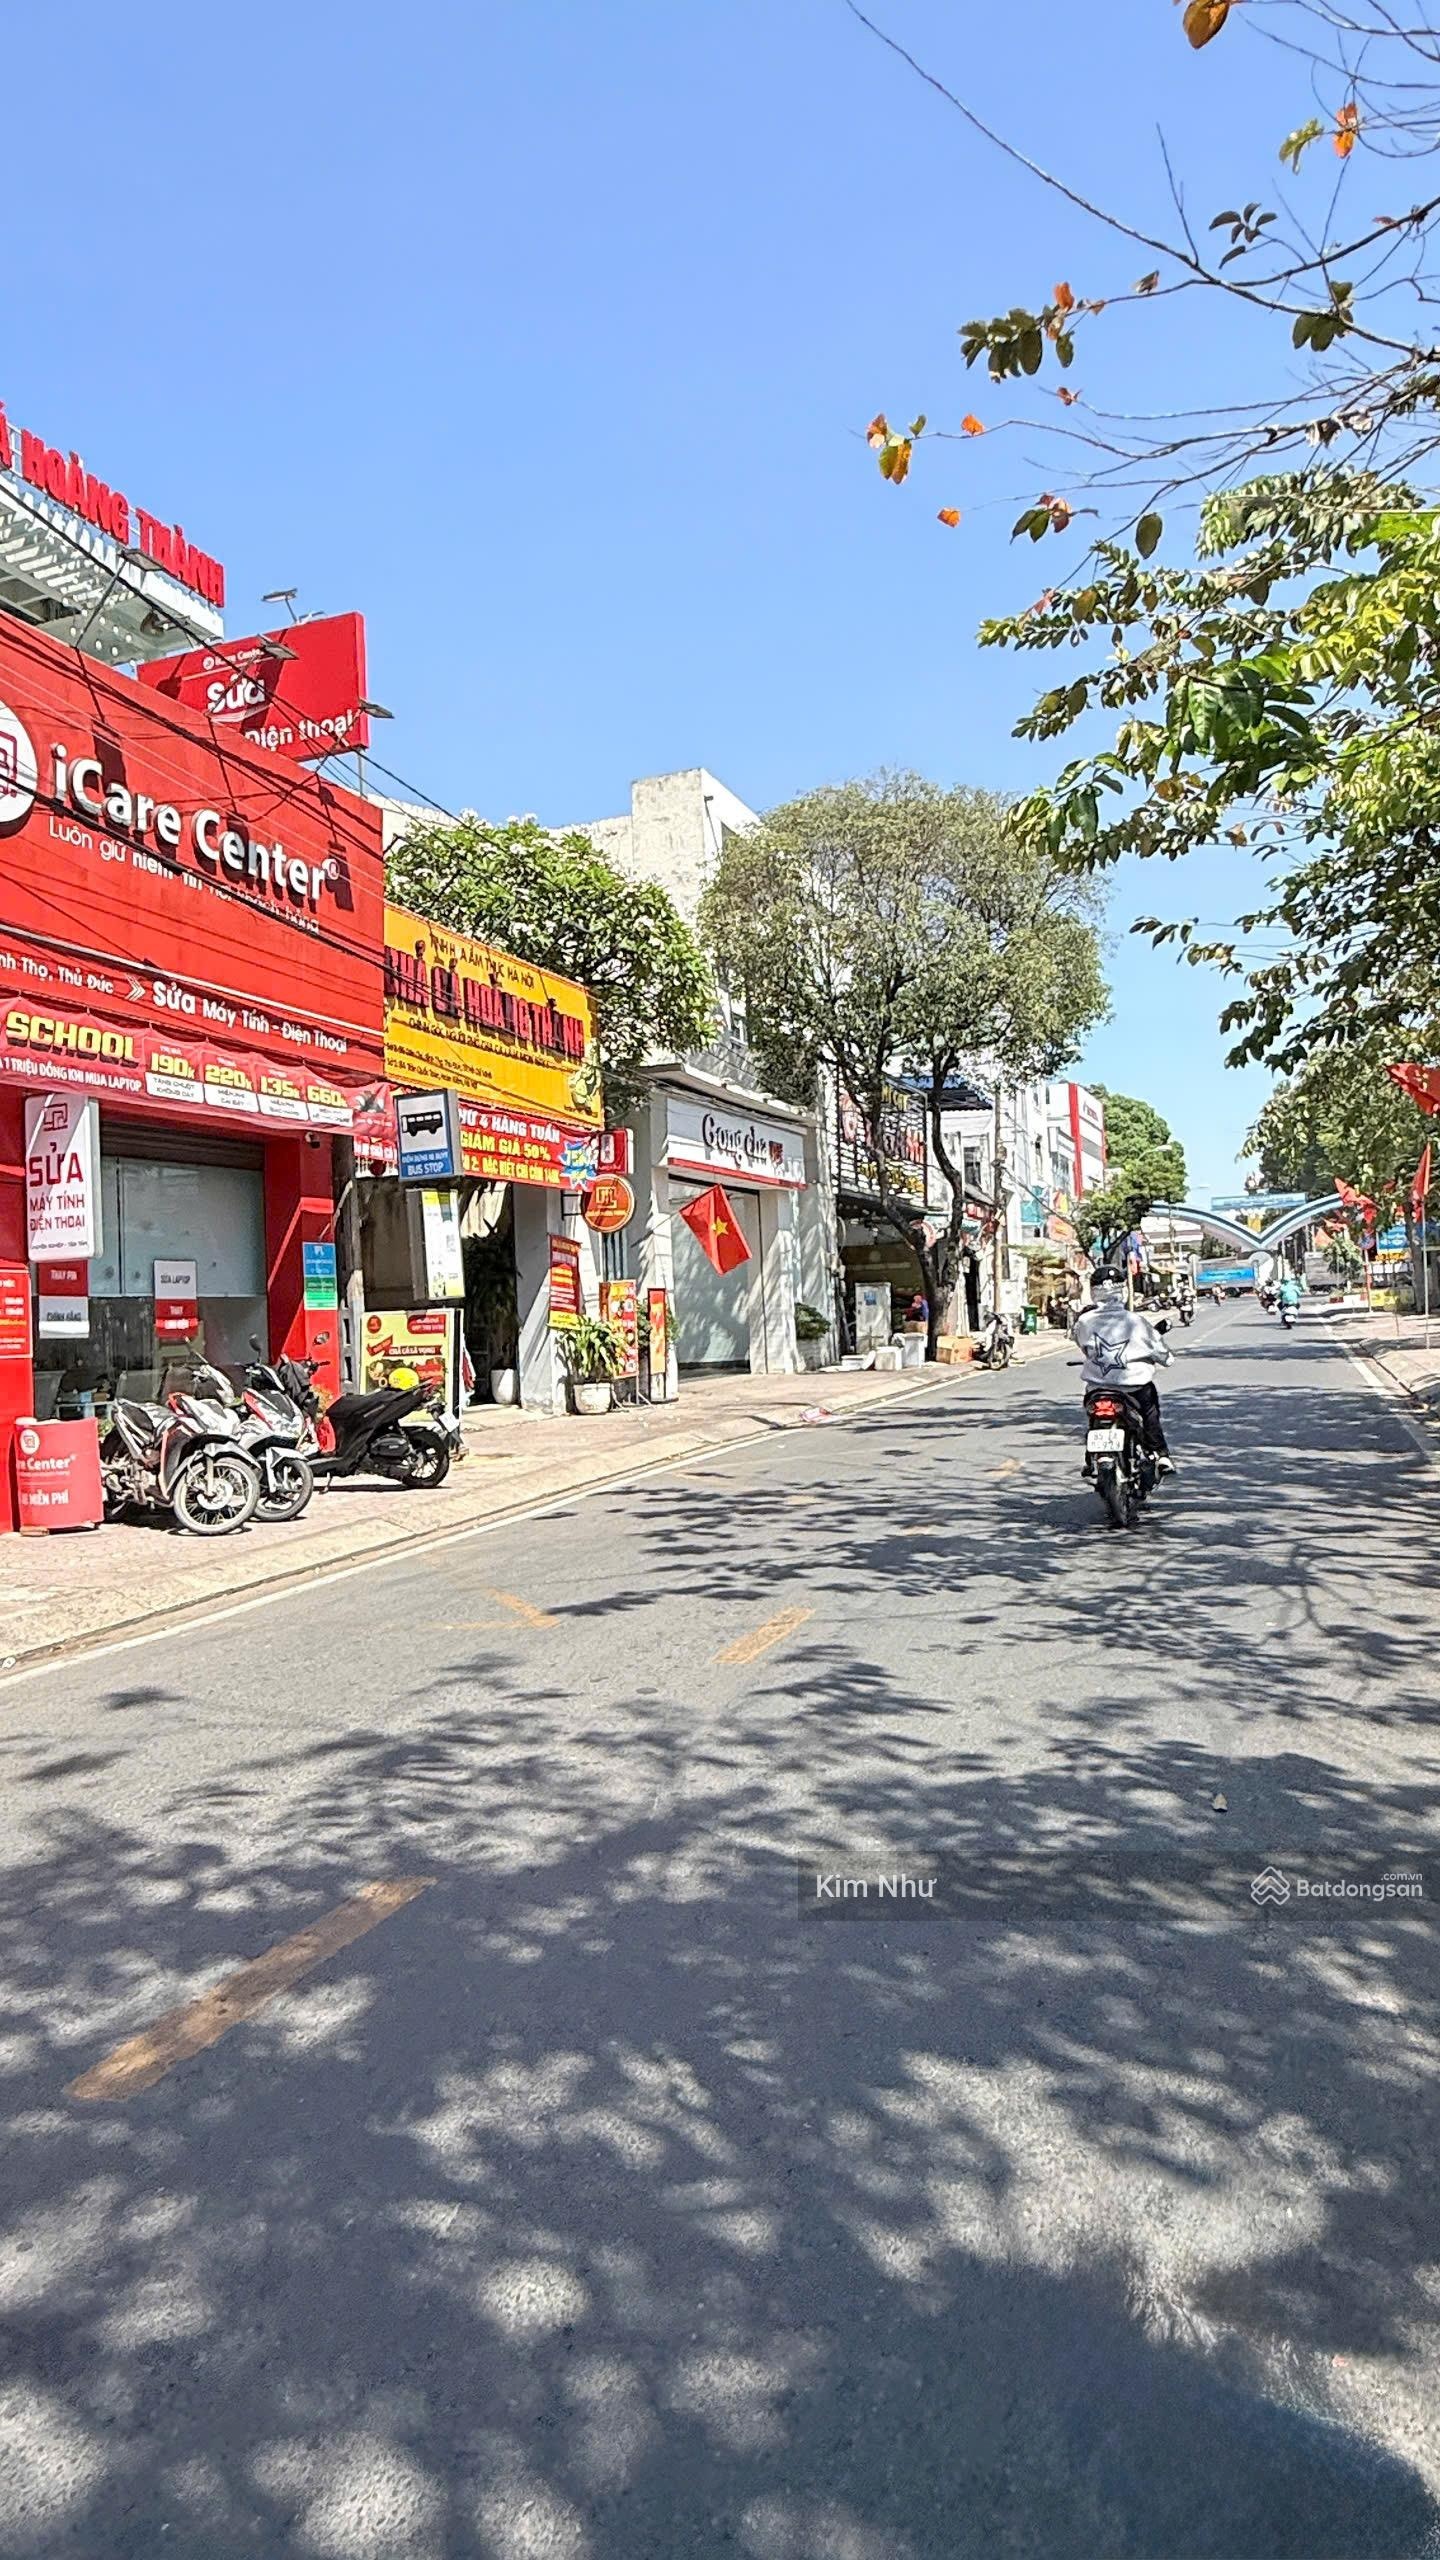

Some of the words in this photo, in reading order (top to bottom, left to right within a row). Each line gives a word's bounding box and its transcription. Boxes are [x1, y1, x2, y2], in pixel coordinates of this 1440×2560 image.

[21, 426, 129, 546] HOÀNG
[136, 507, 225, 608] THÀNH
[53, 742, 182, 848] iCare
[49, 815, 93, 849] Luôn
[99, 838, 128, 863] giữ
[21, 956, 54, 982] Thọ,
[57, 965, 83, 987] Thủ
[152, 981, 196, 1015] Sửa
[202, 1000, 237, 1030] Máy
[242, 1009, 270, 1034] Tính
[281, 1017, 311, 1046] Điện
[313, 1027, 348, 1052] Thoại
[5, 1010, 140, 1063] SCHOOL
[11, 1058, 38, 1076] TRIỆU
[68, 1067, 84, 1083] KHI
[85, 1071, 107, 1087] MUA
[107, 1074, 142, 1092] LAPTOP
[479, 1114, 489, 1128] 4
[28, 1141, 84, 1188] SỬA
[524, 1142, 551, 1161] 50%
[407, 1164, 424, 1176] BUS
[424, 1161, 445, 1174] STOP
[29, 1191, 53, 1212] MÁY
[56, 1190, 85, 1210] TÍNH
[54, 1215, 86, 1231] THOẠI
[27, 1456, 71, 1471] Center
